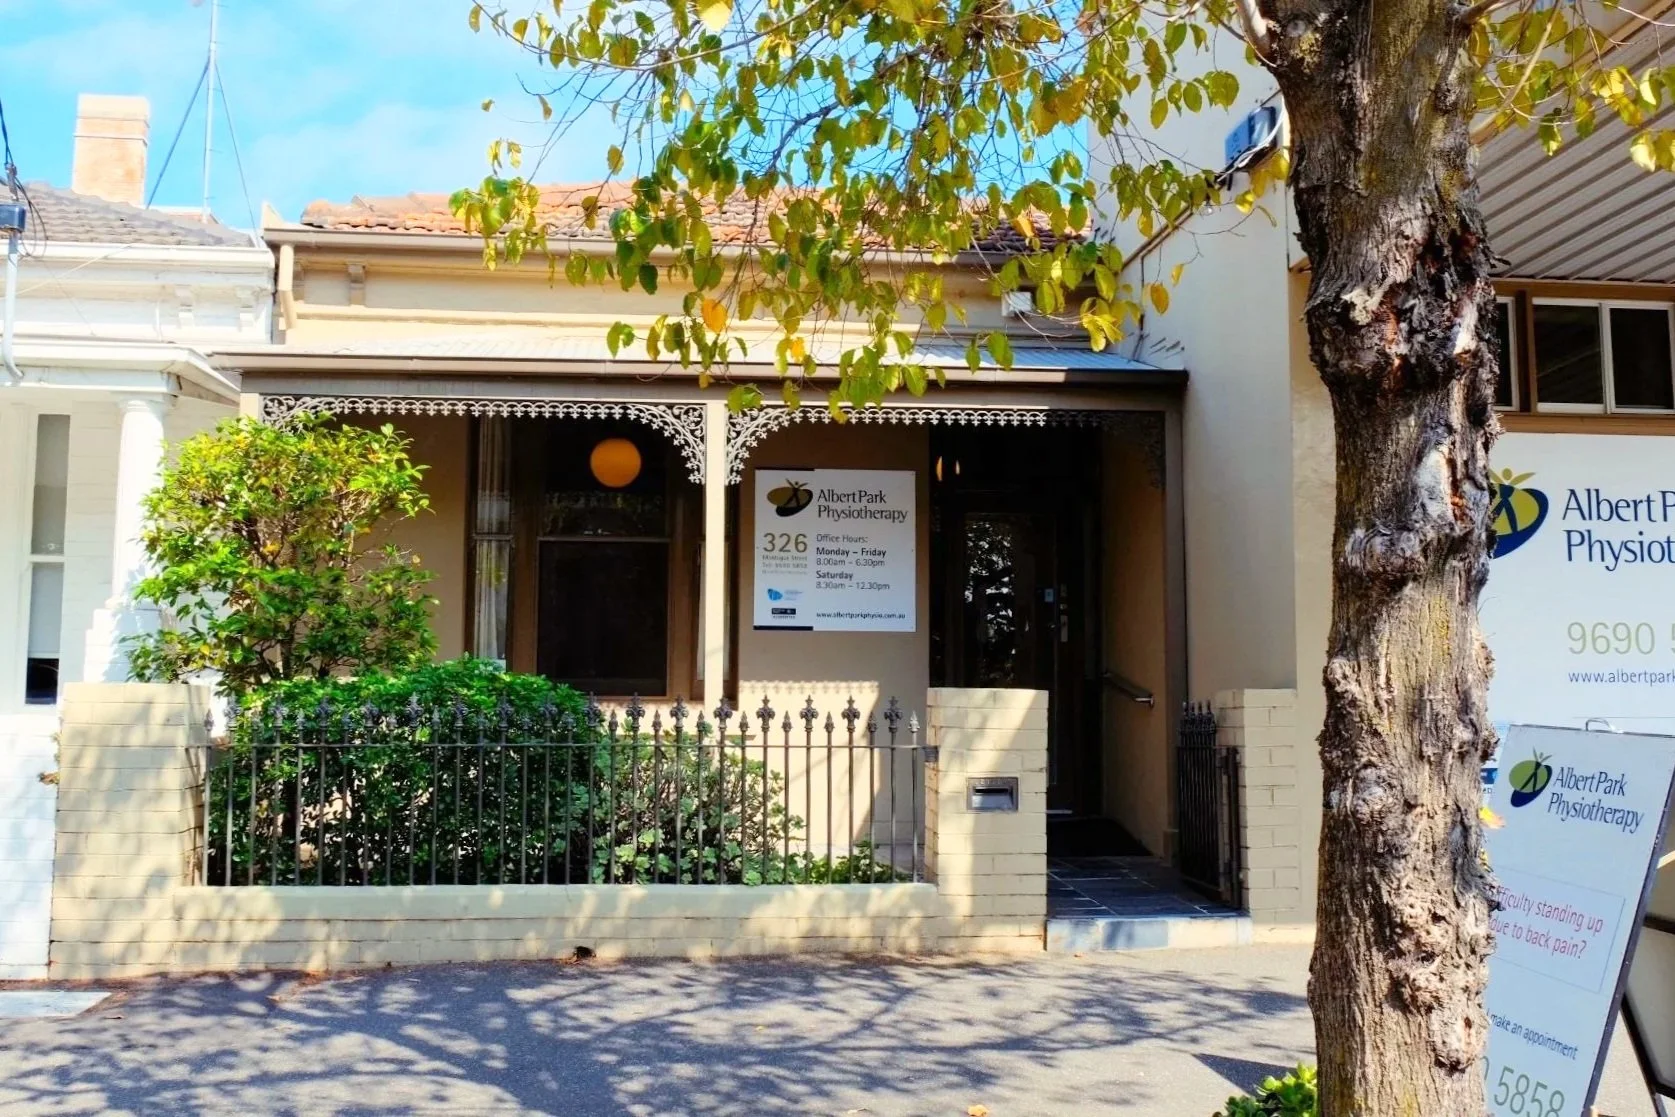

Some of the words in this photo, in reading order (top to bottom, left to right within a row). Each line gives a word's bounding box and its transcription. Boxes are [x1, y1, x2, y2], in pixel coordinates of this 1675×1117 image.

[817, 489, 856, 504] Albert
[858, 490, 887, 504] Park
[1562, 488, 1657, 523] Albert
[817, 505, 909, 523] Physiotherapy
[763, 532, 808, 553] 326
[816, 534, 841, 543] Office
[842, 534, 868, 543] Hours:
[816, 547, 850, 557] Monday
[861, 547, 887, 558] Friday
[816, 558, 846, 566] 8.00am
[855, 558, 885, 568] 6.30pm
[816, 571, 854, 581] Saturday
[816, 582, 846, 590] 8.30am
[856, 582, 891, 591] 12.30pm
[1567, 621, 1656, 655] 9690
[1553, 766, 1596, 793] Albert
[1596, 772, 1628, 797] Park
[1548, 793, 1645, 834] Physiotherapy
[1535, 901, 1585, 932] standing
[1587, 916, 1604, 937] up
[1512, 921, 1523, 940] to
[1525, 924, 1552, 949] back
[1552, 936, 1587, 959] pain?
[1491, 1013, 1511, 1032] make
[1511, 1023, 1523, 1036] an
[1523, 1027, 1579, 1060] appointment
[1494, 1065, 1565, 1117] 5858
